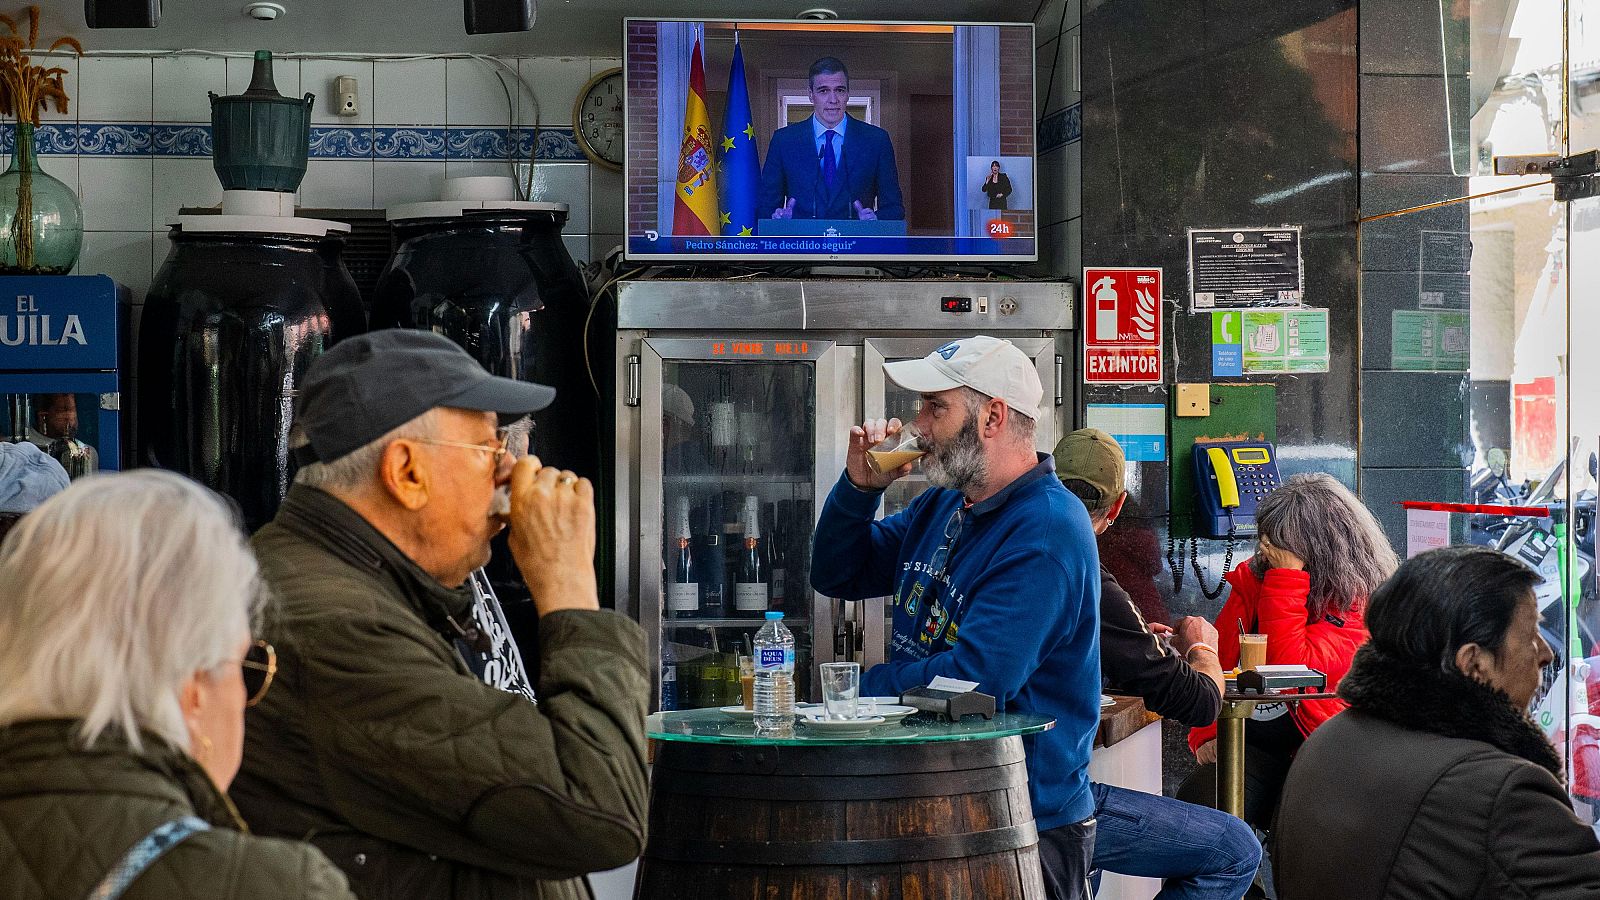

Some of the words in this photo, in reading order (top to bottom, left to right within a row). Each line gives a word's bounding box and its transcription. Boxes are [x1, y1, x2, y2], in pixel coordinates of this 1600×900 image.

[607, 84, 613, 94] 11
[594, 96, 602, 107] 10
[588, 112, 595, 123] 9
[592, 128, 599, 139] 8
[606, 140, 612, 150] 7
[990, 223, 1010, 234] 24h
[685, 240, 714, 250] Pedro
[715, 240, 758, 250] Sánchez:
[760, 240, 778, 250] "He
[779, 240, 821, 250] decidido
[822, 240, 856, 252] seguir"
[17, 295, 39, 312] EL
[713, 342, 725, 354] SE
[732, 342, 763, 354] VENDE
[775, 342, 808, 354] HIELO
[1089, 355, 1157, 373] EXTINTOR
